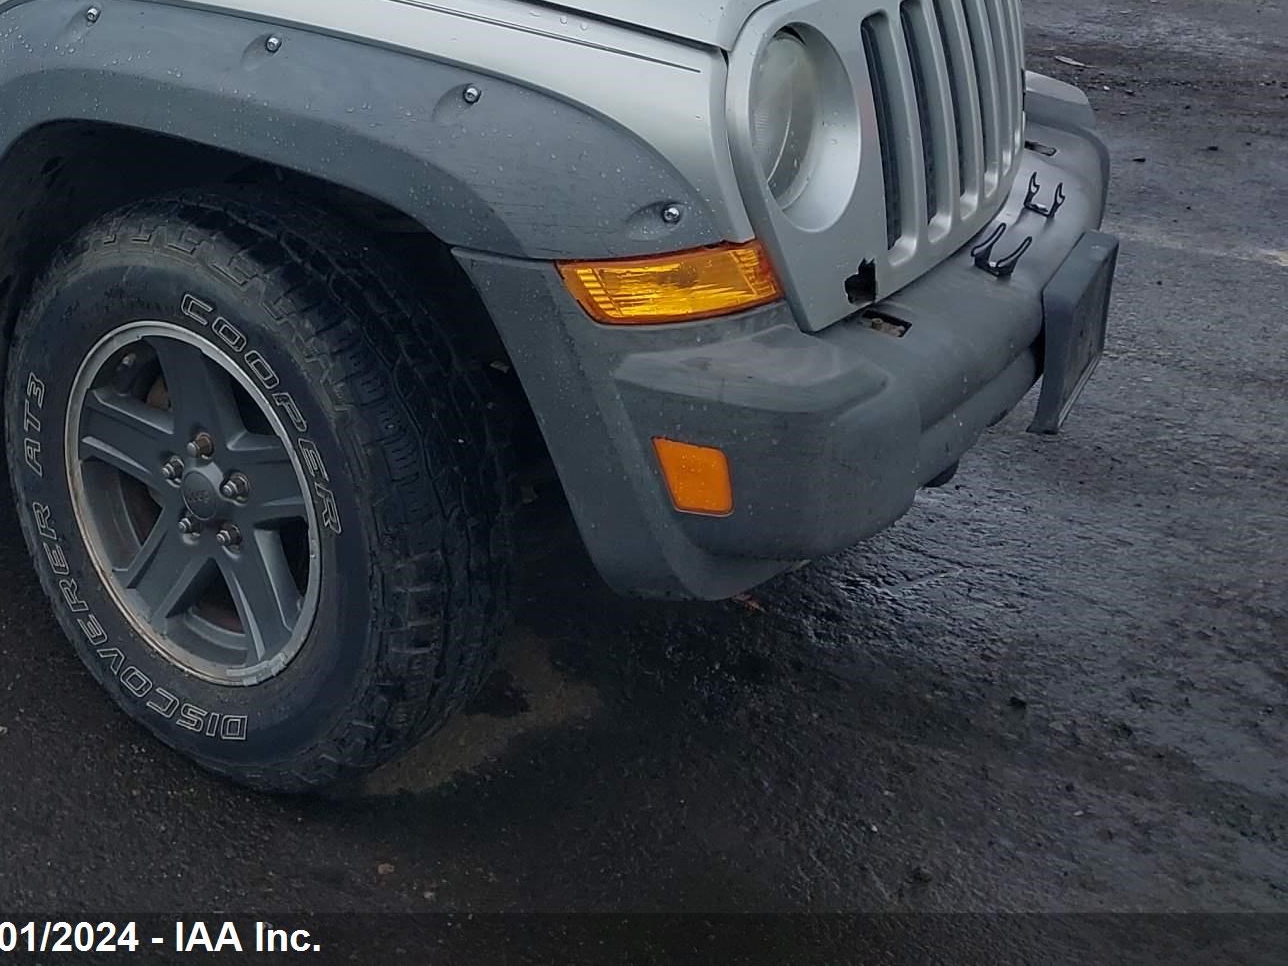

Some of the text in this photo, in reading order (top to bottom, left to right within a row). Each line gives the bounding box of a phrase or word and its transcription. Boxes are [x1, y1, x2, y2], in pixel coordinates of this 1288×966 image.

[24, 370, 249, 742] DISCOVERER AT3
[180, 292, 344, 535] COOPER
